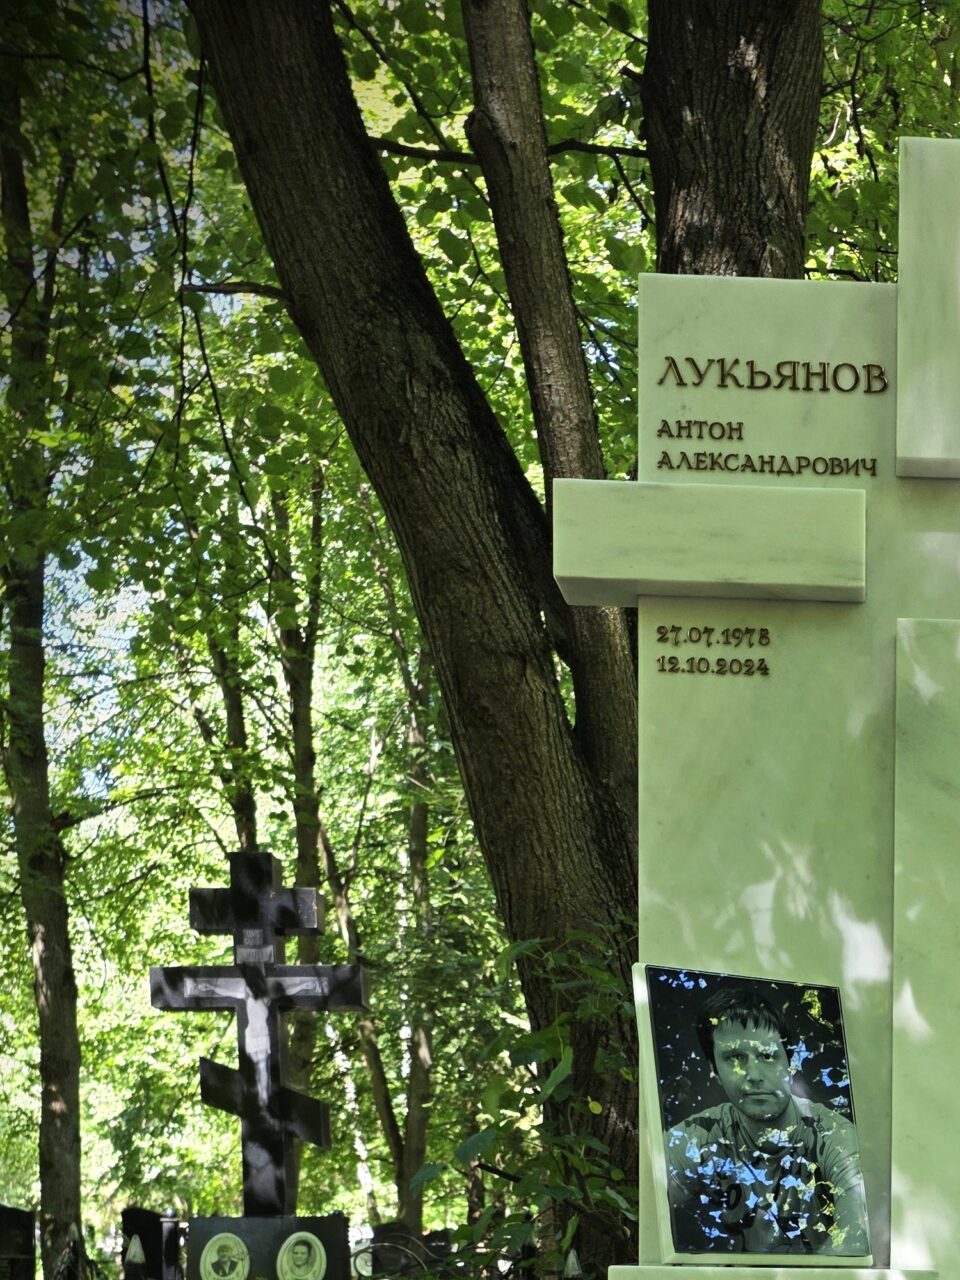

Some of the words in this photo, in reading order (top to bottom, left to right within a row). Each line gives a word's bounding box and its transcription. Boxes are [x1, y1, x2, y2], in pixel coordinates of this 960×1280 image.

[657, 356, 888, 394] ЛУКЬЯНОВ
[657, 419, 744, 441] АНТОН
[657, 451, 878, 477] АЛЕКСАНДРОВИЧ
[656, 625, 771, 648] 27.07.1978
[656, 656, 770, 676] 12.10.2024
